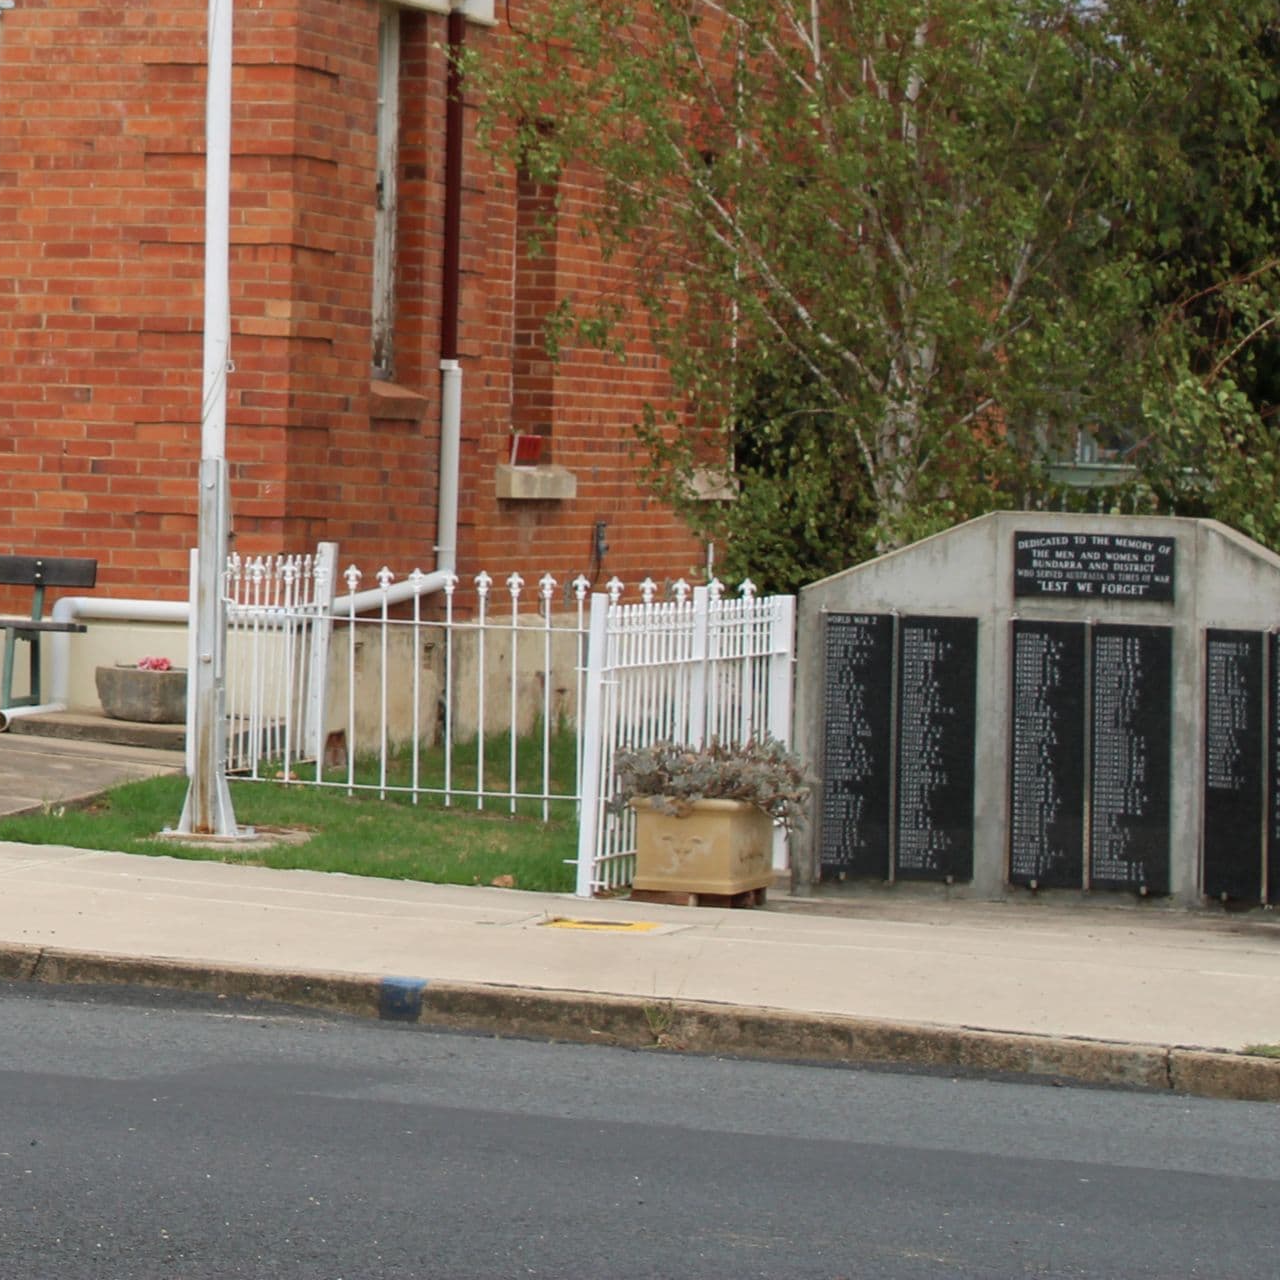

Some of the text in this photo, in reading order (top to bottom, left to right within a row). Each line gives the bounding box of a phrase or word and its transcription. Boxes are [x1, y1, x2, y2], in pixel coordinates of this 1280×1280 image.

[1017, 535, 1172, 555] DEDICATED TO THE MEMORY OF
[1032, 549, 1156, 562] THE MEN AND WOMEN OF
[1032, 559, 1156, 573] BUNDARRA AND DISTRICT
[1076, 582, 1093, 593] WE
